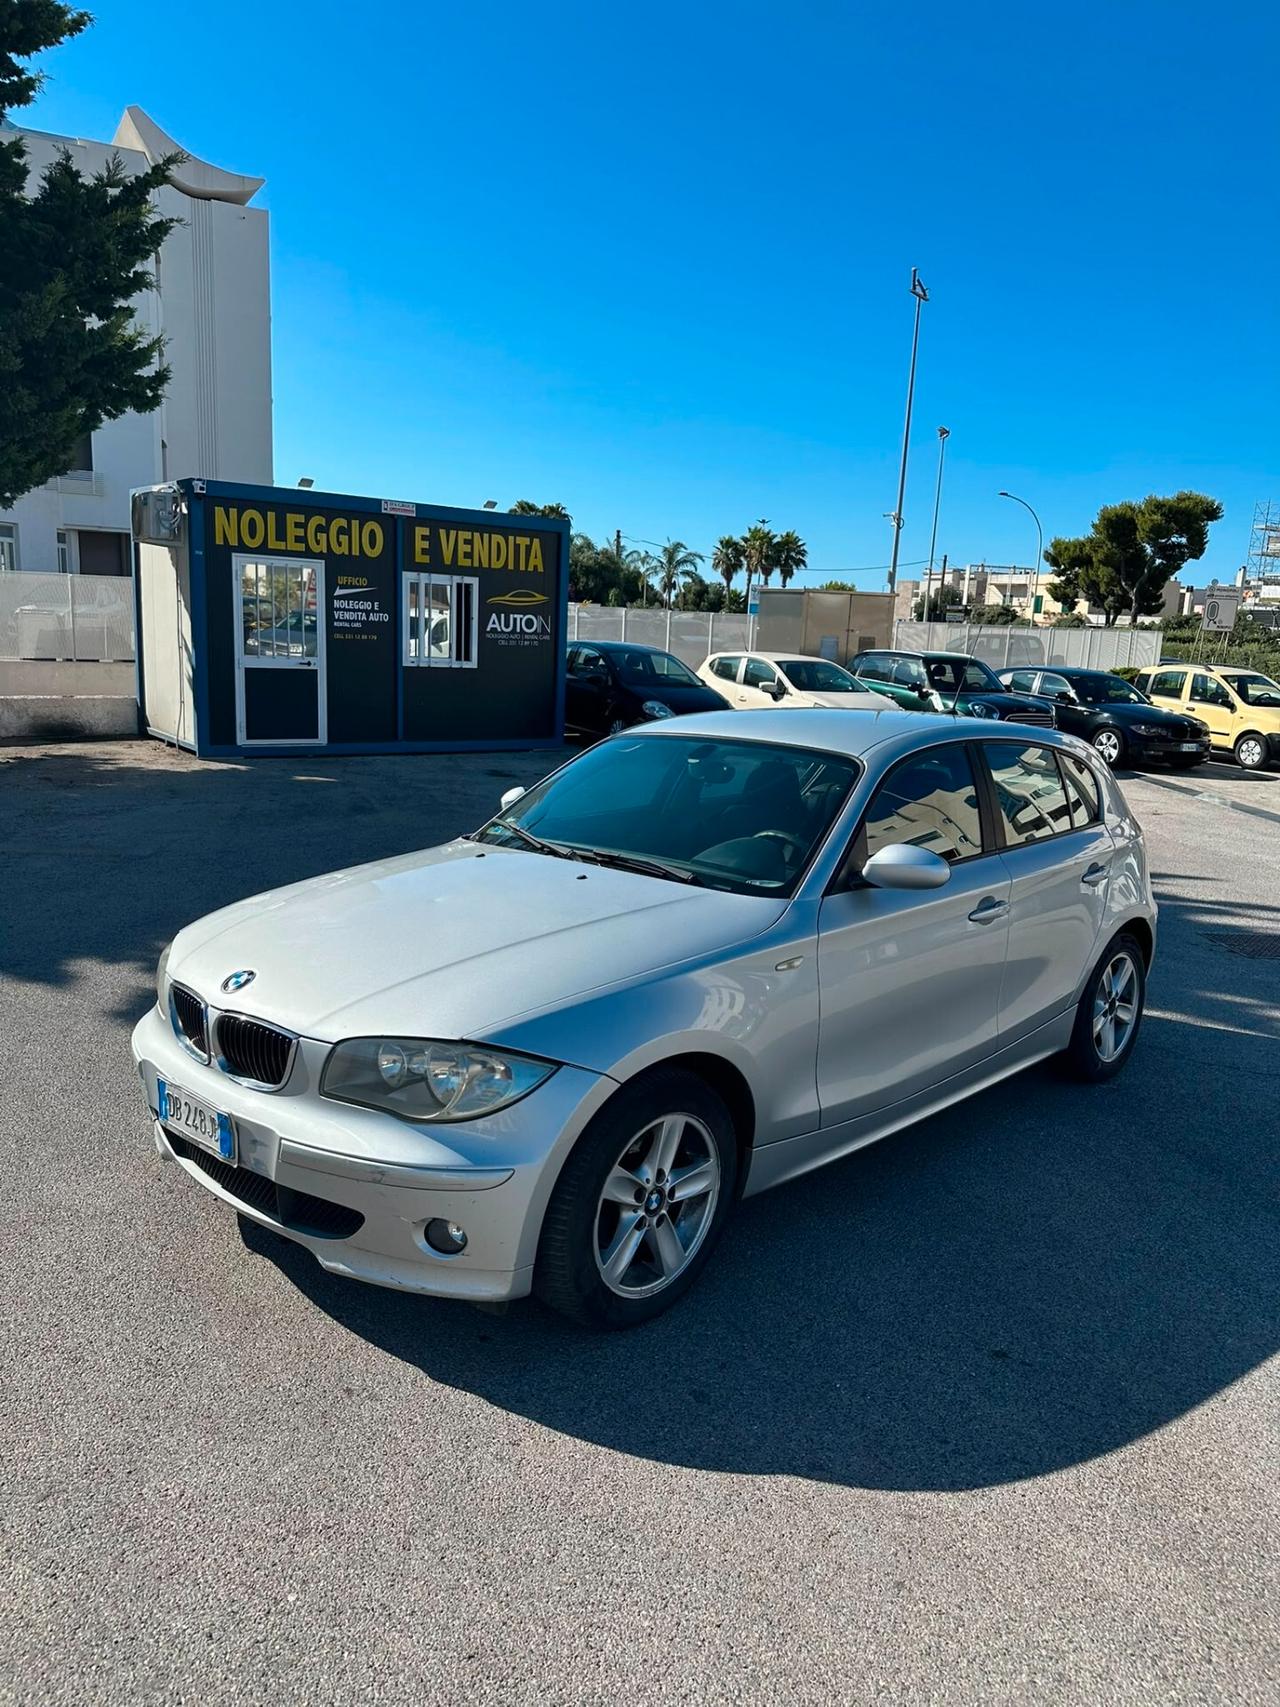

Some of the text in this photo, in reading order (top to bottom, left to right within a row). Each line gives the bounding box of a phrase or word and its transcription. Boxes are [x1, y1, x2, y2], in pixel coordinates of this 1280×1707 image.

[214, 506, 544, 573] NOLEGGIO E VENDITA
[337, 576, 368, 586] UFFICIO
[333, 600, 380, 610] NOLEGGIO E
[333, 611, 389, 622] VENDITA AUTO
[166, 1092, 182, 1121] DB
